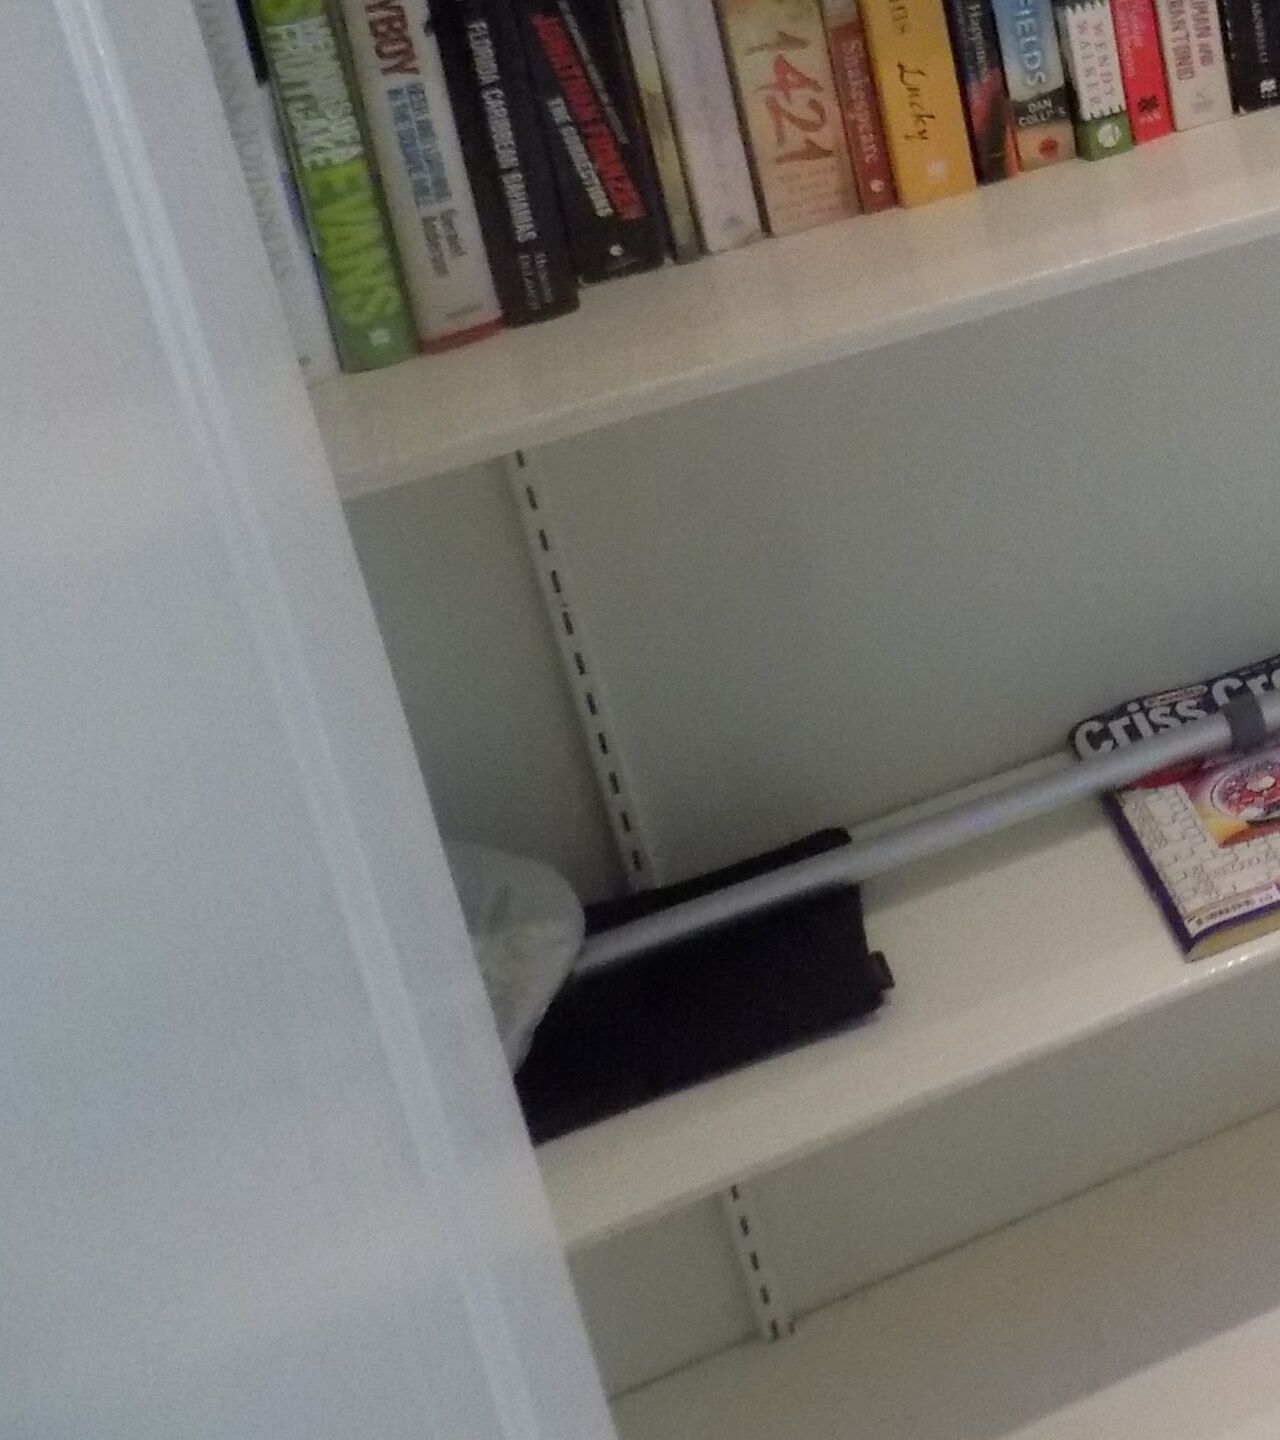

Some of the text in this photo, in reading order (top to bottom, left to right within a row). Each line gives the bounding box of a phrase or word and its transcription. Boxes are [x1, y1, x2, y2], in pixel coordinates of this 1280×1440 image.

[467, 20, 499, 85] FLORIDA
[1092, 21, 1115, 98] WENDY
[481, 87, 520, 171] CARIBBEAN
[744, 31, 834, 165] 1421
[840, 38, 878, 166] Shakespeare
[896, 57, 937, 145] Lucky
[503, 172, 537, 243] BAHAMAS
